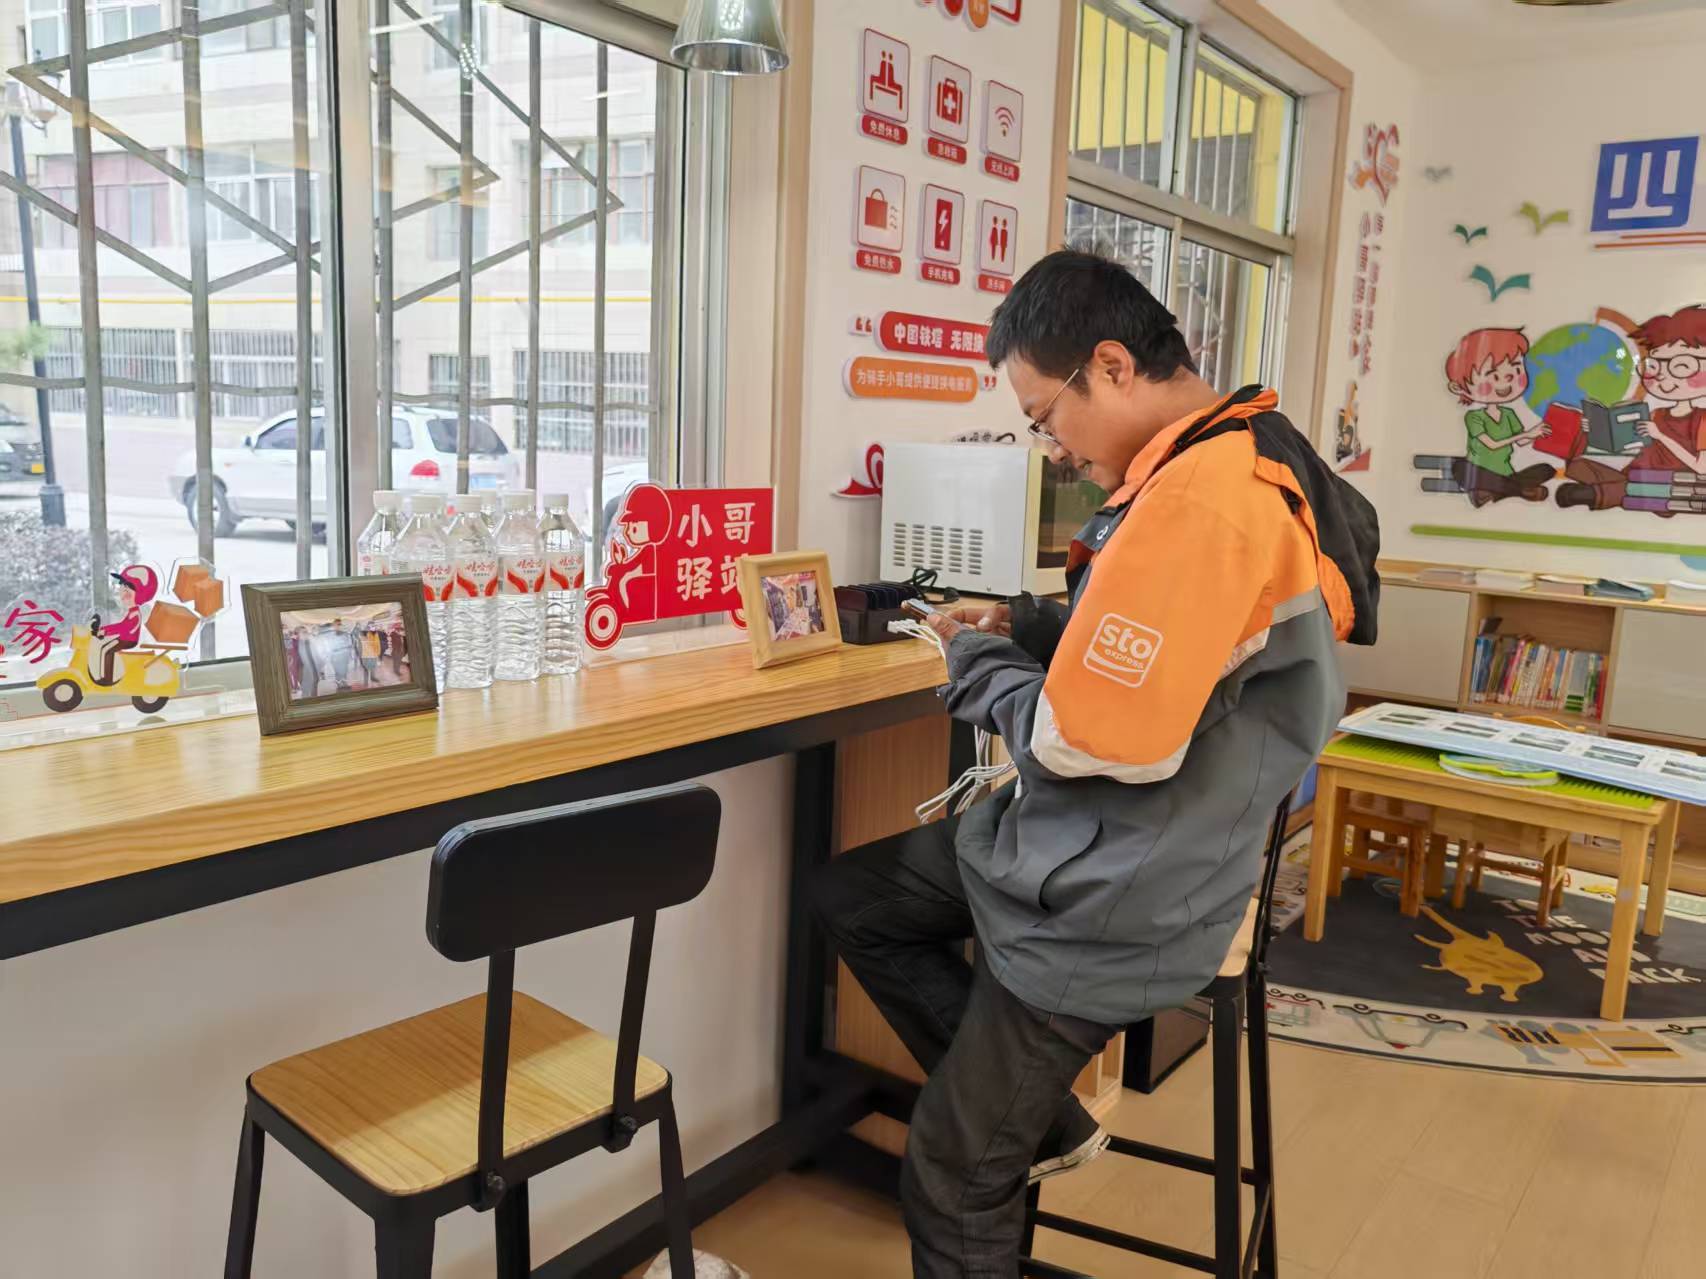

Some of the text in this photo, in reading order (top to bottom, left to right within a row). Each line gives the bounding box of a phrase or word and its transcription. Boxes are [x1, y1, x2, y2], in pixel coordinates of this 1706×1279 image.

[928, 266, 955, 283] 手机充电
[894, 322, 944, 348] 中国铁塔
[677, 502, 756, 547] 小哥
[1104, 648, 1145, 669] express
